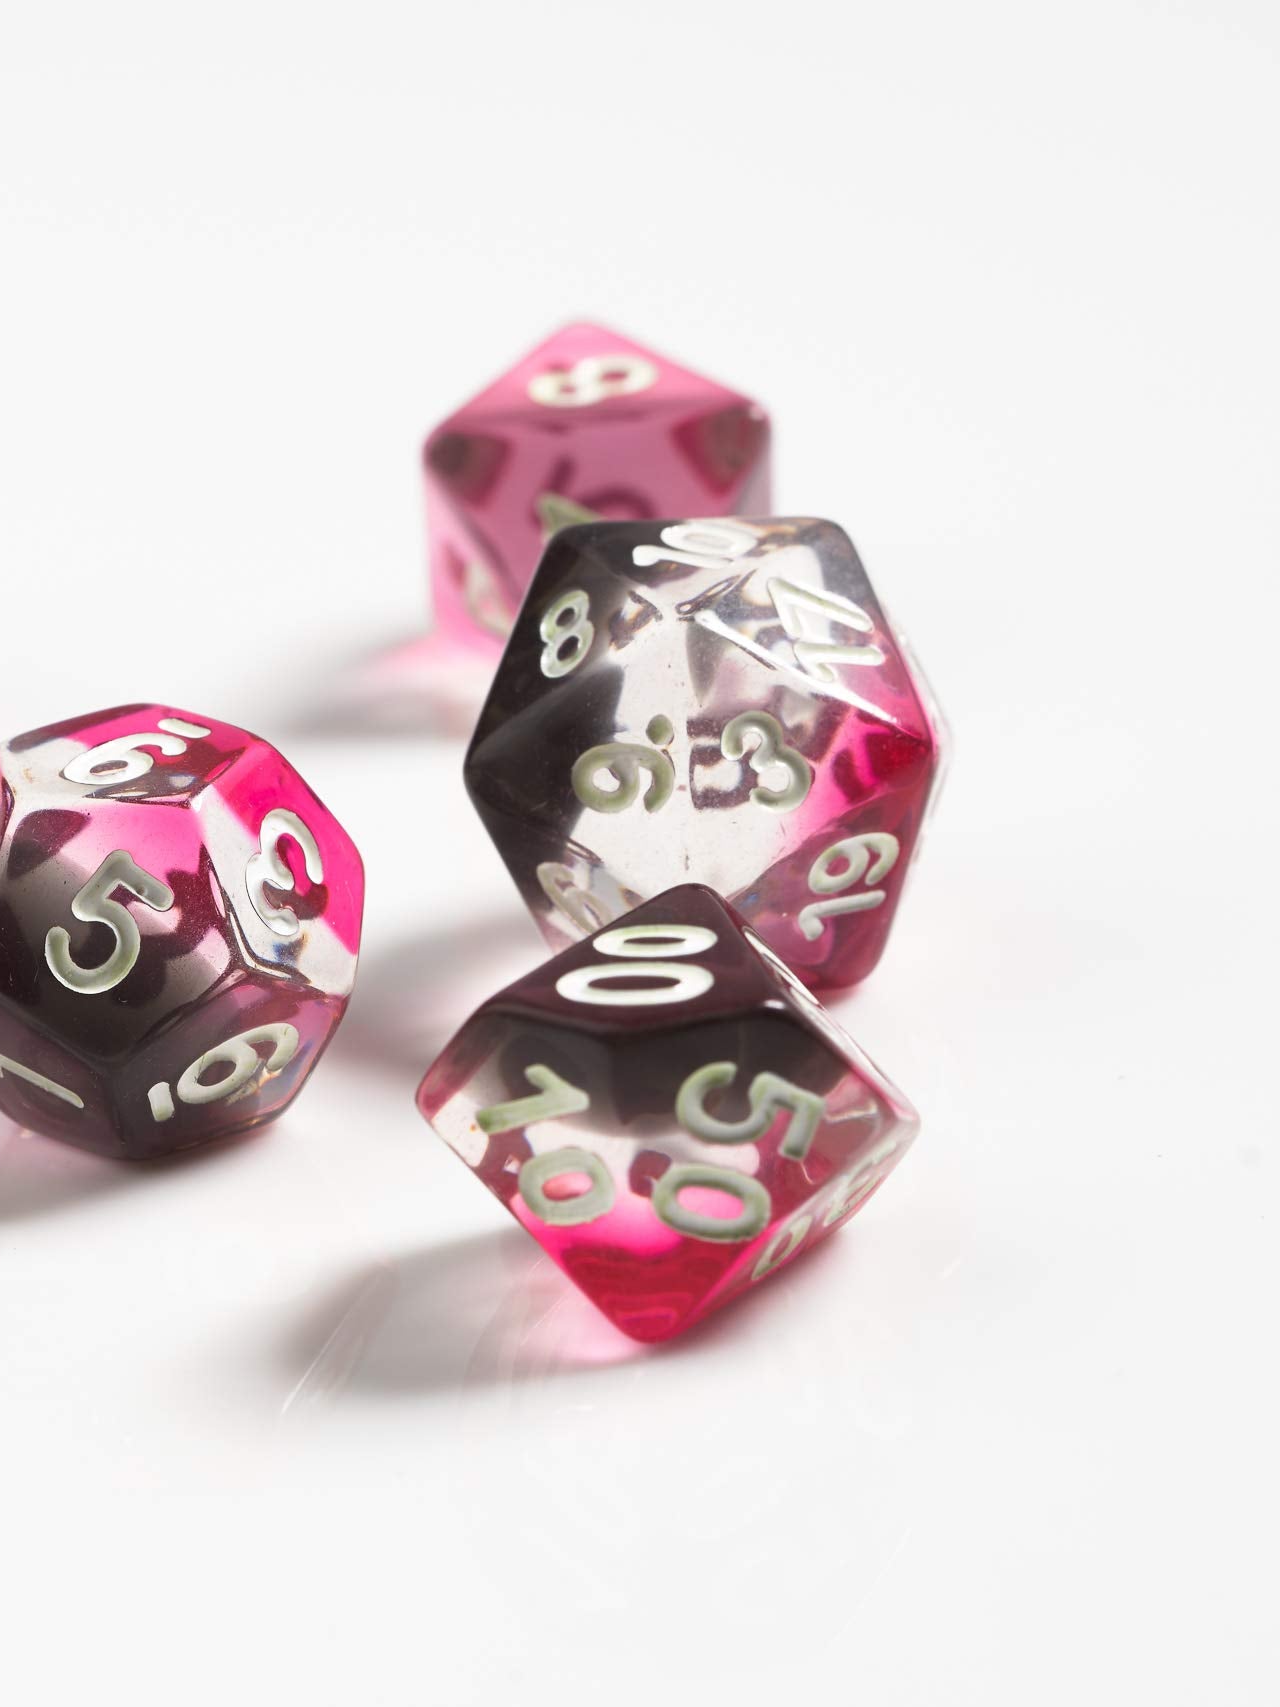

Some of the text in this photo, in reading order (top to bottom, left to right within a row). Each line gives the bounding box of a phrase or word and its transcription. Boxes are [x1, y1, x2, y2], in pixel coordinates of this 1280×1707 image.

[632, 523, 757, 570] 10
[540, 589, 595, 678] 8
[721, 710, 812, 814] 3
[44, 849, 175, 995] 5
[245, 808, 324, 936] 3
[555, 924, 718, 1006] 00
[476, 1062, 616, 1226] 10
[652, 1061, 826, 1244] 50
